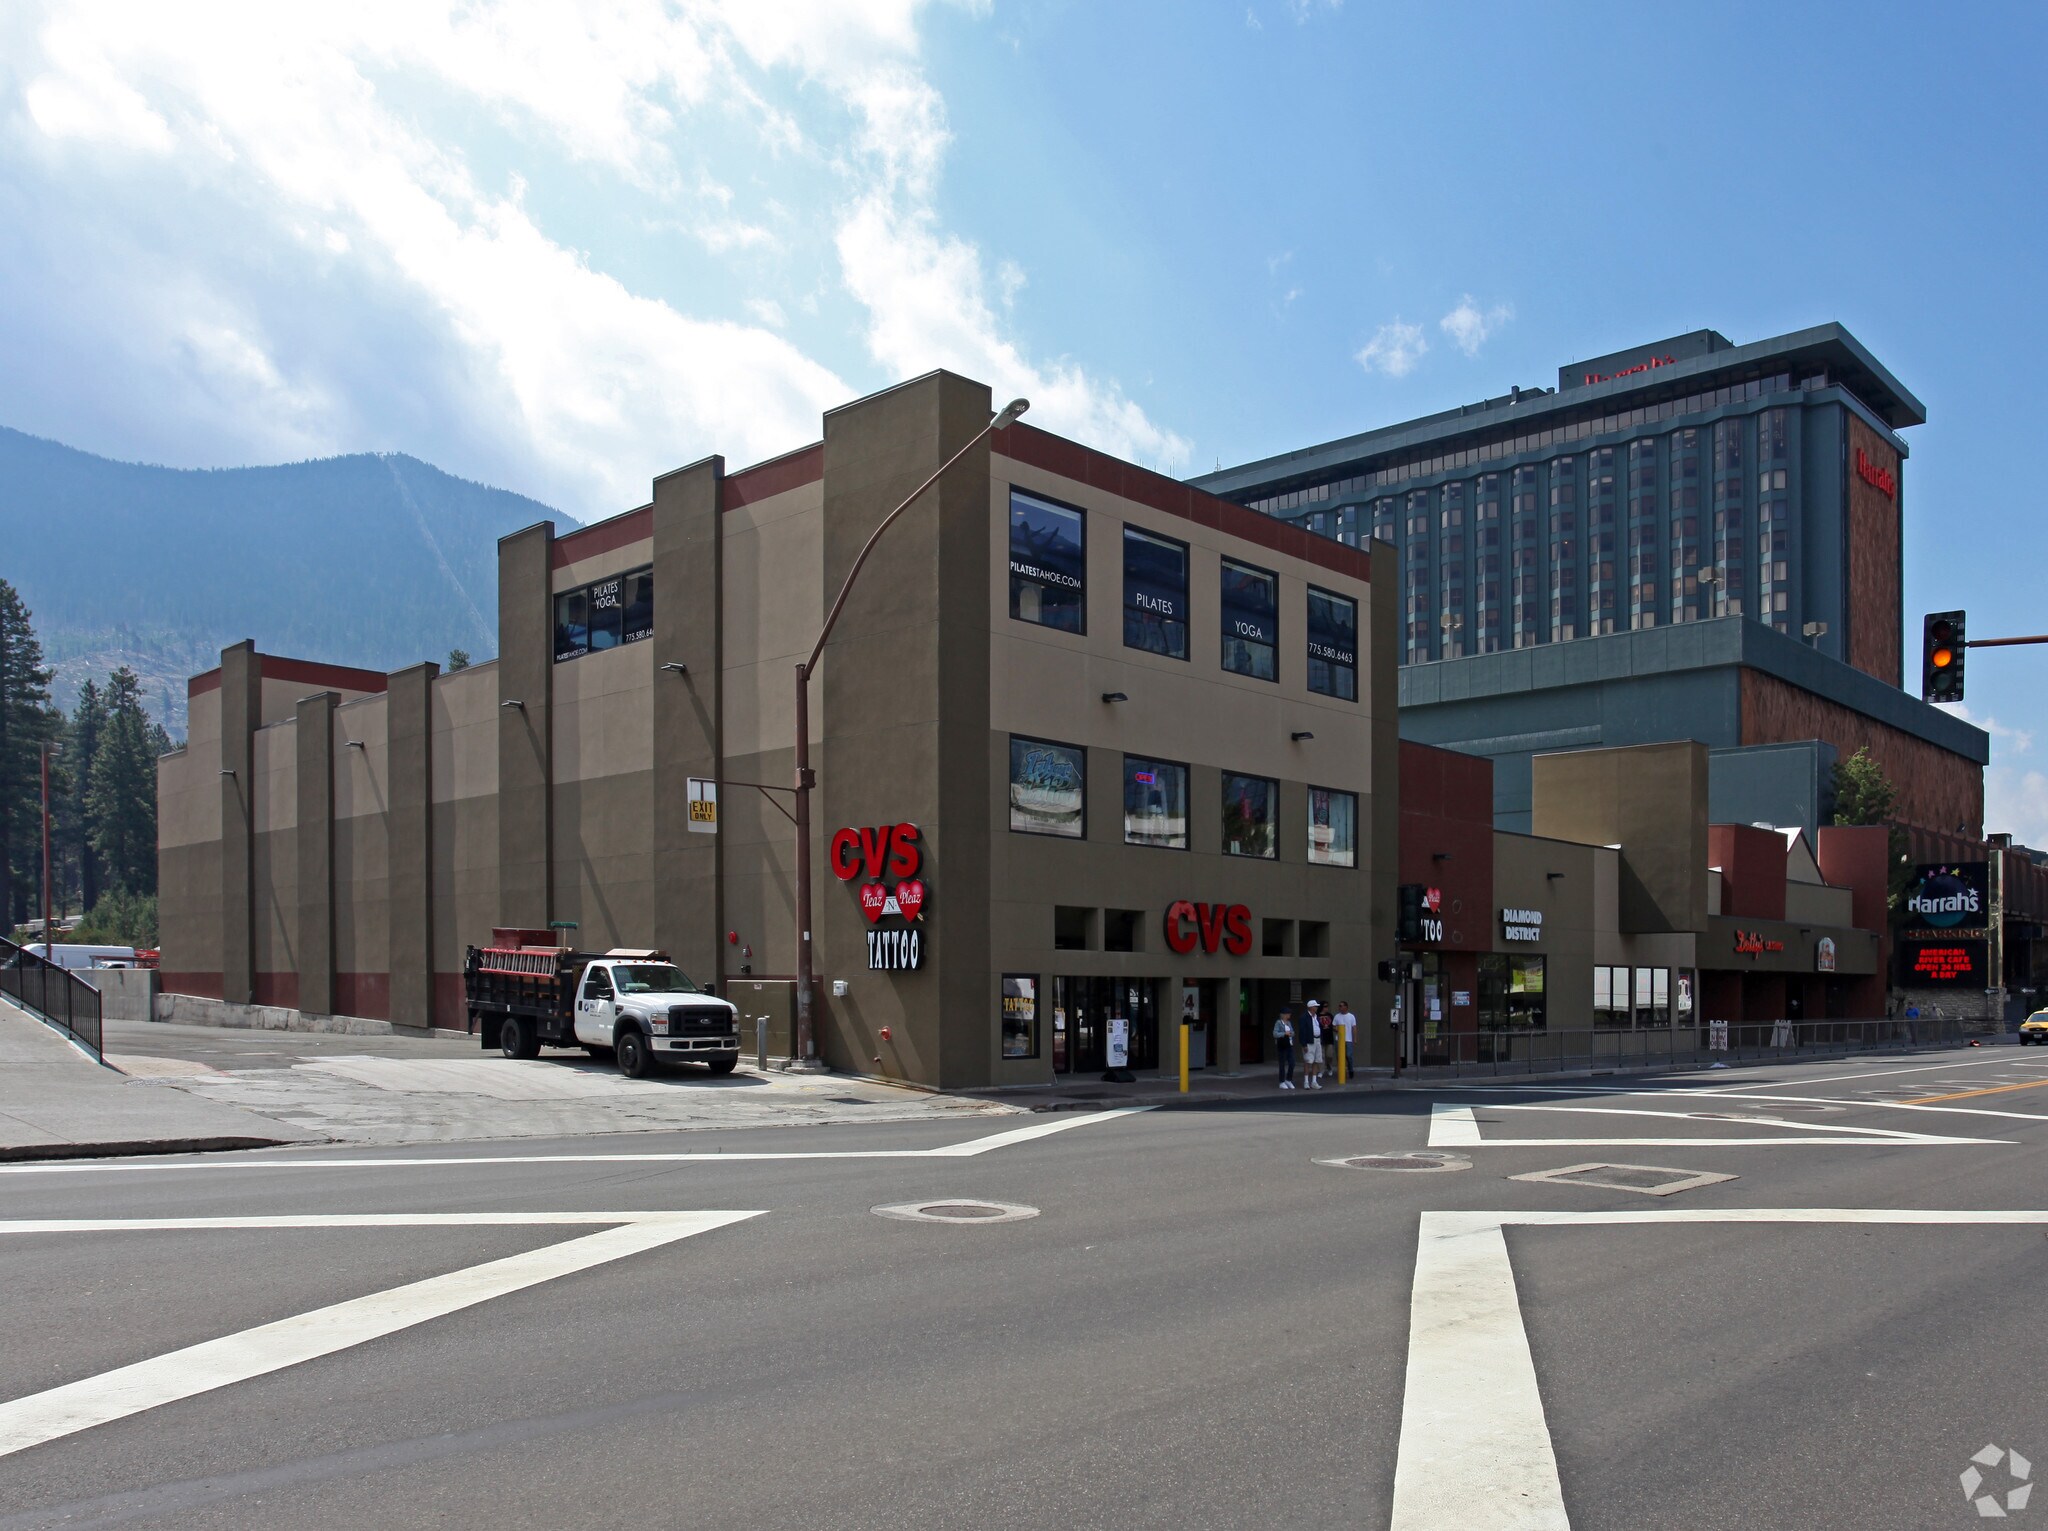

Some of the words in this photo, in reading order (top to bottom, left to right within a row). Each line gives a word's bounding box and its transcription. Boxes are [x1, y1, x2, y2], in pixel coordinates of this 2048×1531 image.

[1010, 561, 1081, 588] PILATESTAHOE.COM
[593, 582, 618, 598] PILATES
[595, 595, 616, 609] YOGA
[1136, 592, 1172, 614] PILATES
[1235, 620, 1262, 639] YOGA
[1309, 642, 1352, 663] 775.580.6463
[692, 801, 713, 813] EXIT
[694, 812, 711, 820] ONLY
[831, 823, 920, 880] CVS
[863, 893, 882, 907] Teaz
[900, 890, 921, 905] Pleaz
[1503, 908, 1542, 924] DIAMOND
[1164, 900, 1252, 955] CVS
[1505, 926, 1540, 941] DISTRICT
[867, 930, 919, 969] TATTOO
[1004, 997, 1034, 1011] TATTOO
